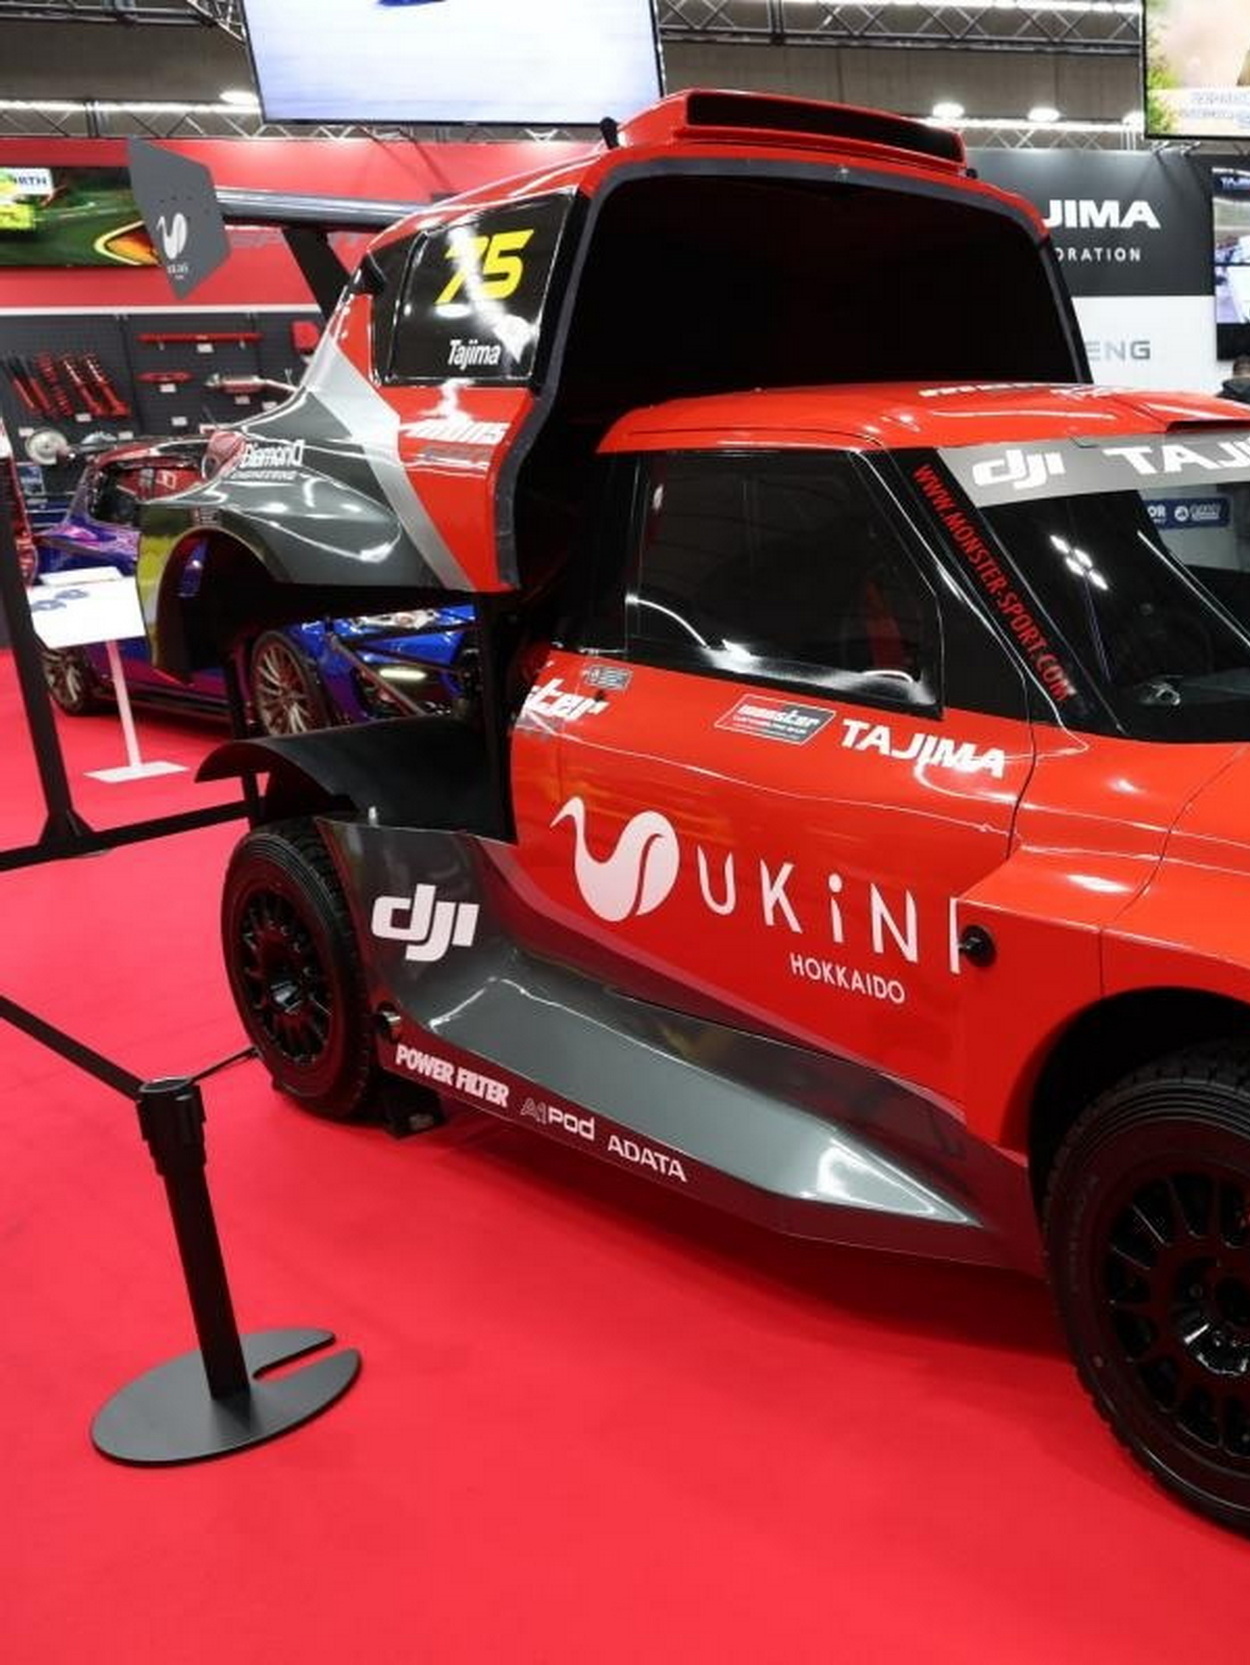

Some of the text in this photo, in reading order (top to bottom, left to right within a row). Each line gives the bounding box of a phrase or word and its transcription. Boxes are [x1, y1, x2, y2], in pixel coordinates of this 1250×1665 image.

[434, 228, 535, 306] 75
[448, 339, 500, 371] Tajima
[841, 718, 1005, 779] TAJIMA
[789, 953, 907, 1005] HOKKAIDO
[395, 1044, 510, 1108] POWER FILTER
[606, 1135, 688, 1182] ADATA
